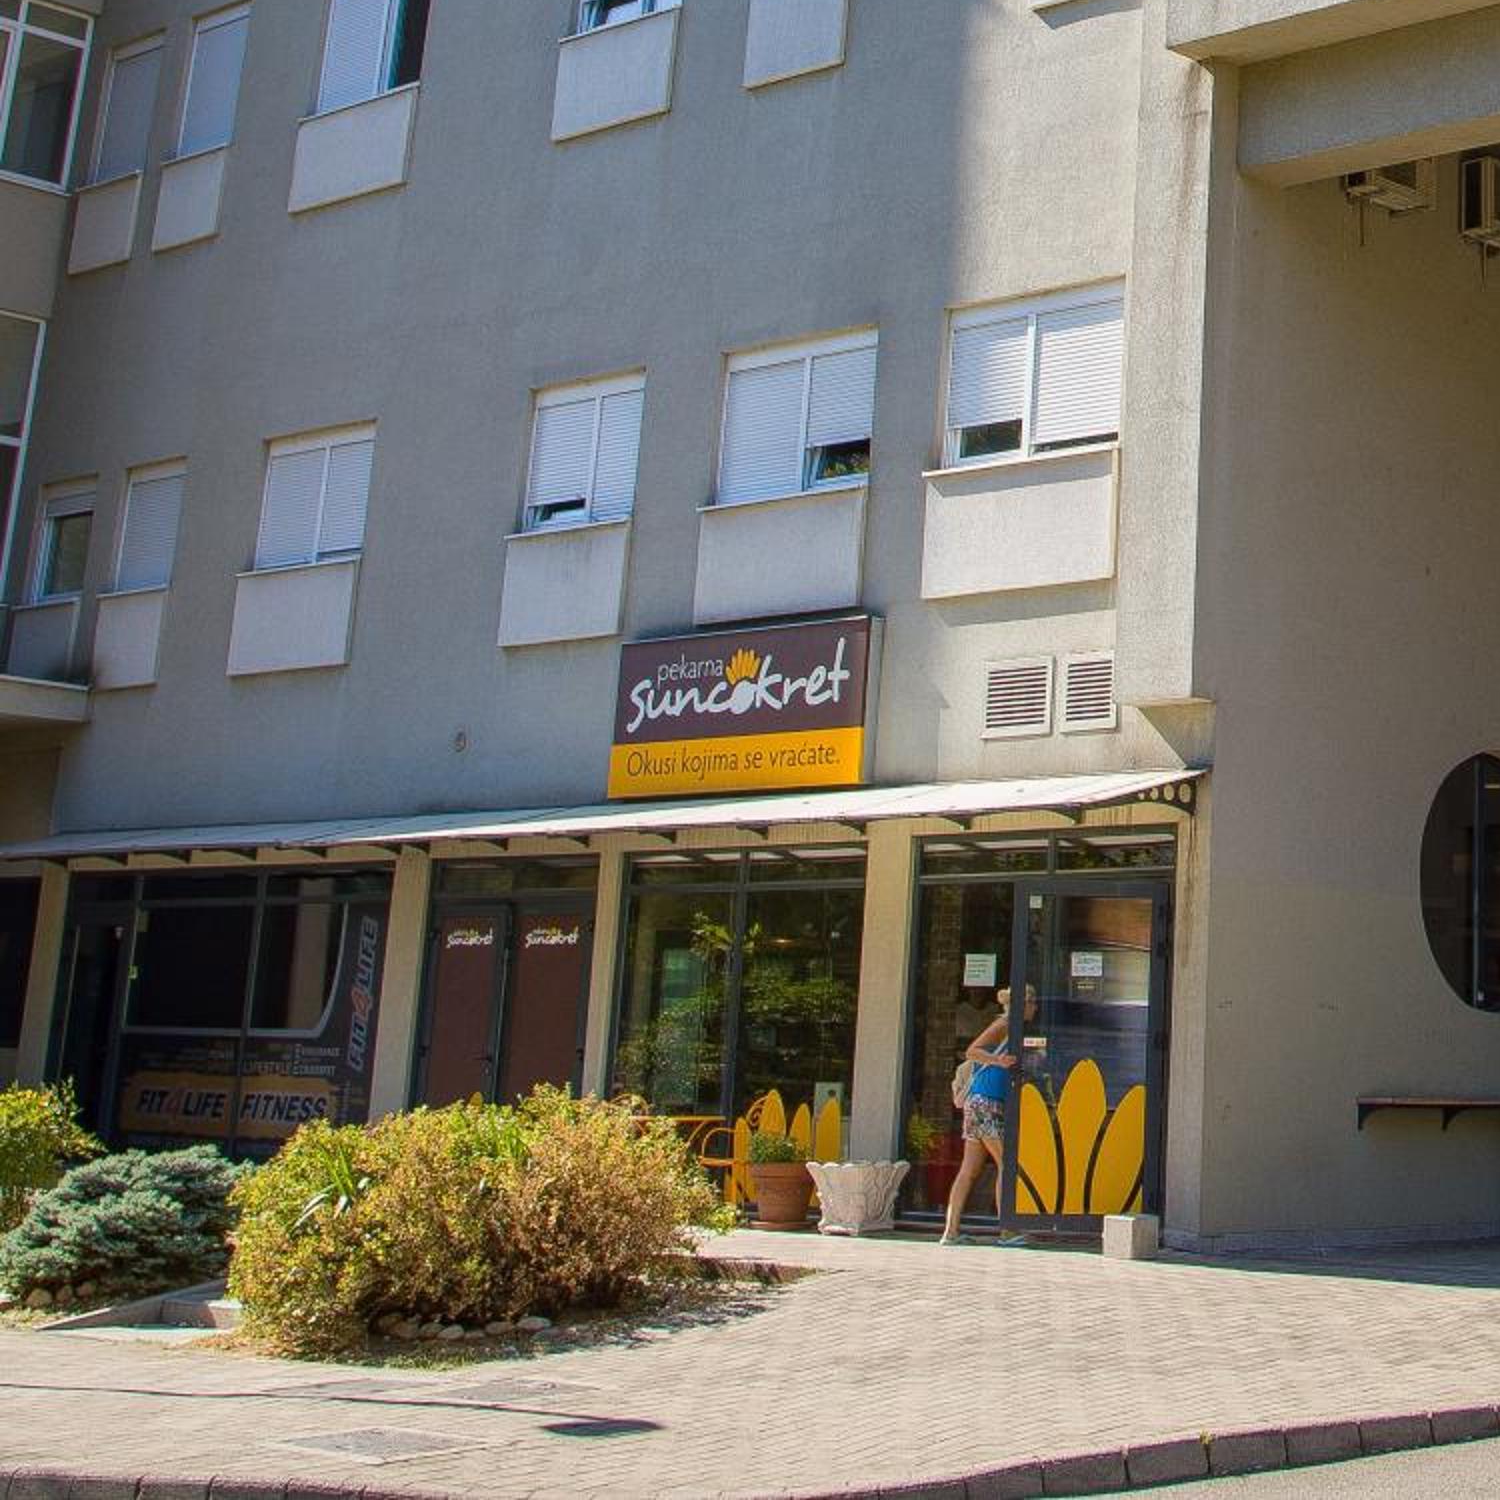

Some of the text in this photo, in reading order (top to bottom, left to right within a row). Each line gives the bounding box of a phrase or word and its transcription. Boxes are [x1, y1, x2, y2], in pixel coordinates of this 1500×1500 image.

[626, 637, 851, 733] suncokret
[657, 652, 724, 686] pekarna
[627, 747, 677, 778] Okusi
[681, 746, 739, 780] kojima
[743, 753, 763, 770] se
[239, 1092, 328, 1122] FITNESS
